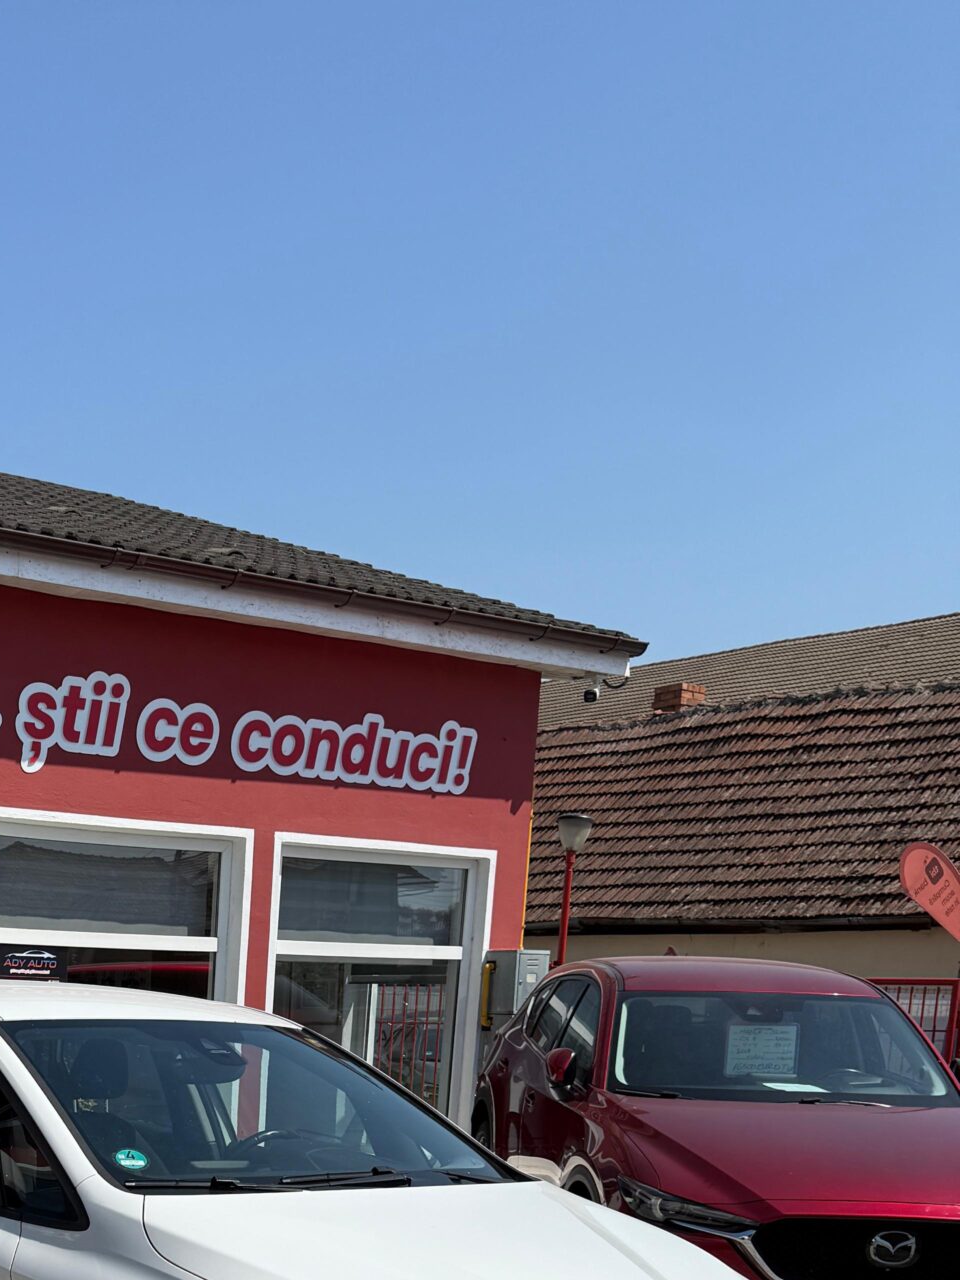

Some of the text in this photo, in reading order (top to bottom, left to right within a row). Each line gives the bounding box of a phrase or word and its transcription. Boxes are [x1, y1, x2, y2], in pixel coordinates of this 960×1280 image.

[22, 677, 128, 766] știi
[142, 705, 214, 759] ce
[237, 721, 473, 788] conduci!
[3, 958, 58, 969] ADY AUTO
[126, 1150, 136, 1160] 4
